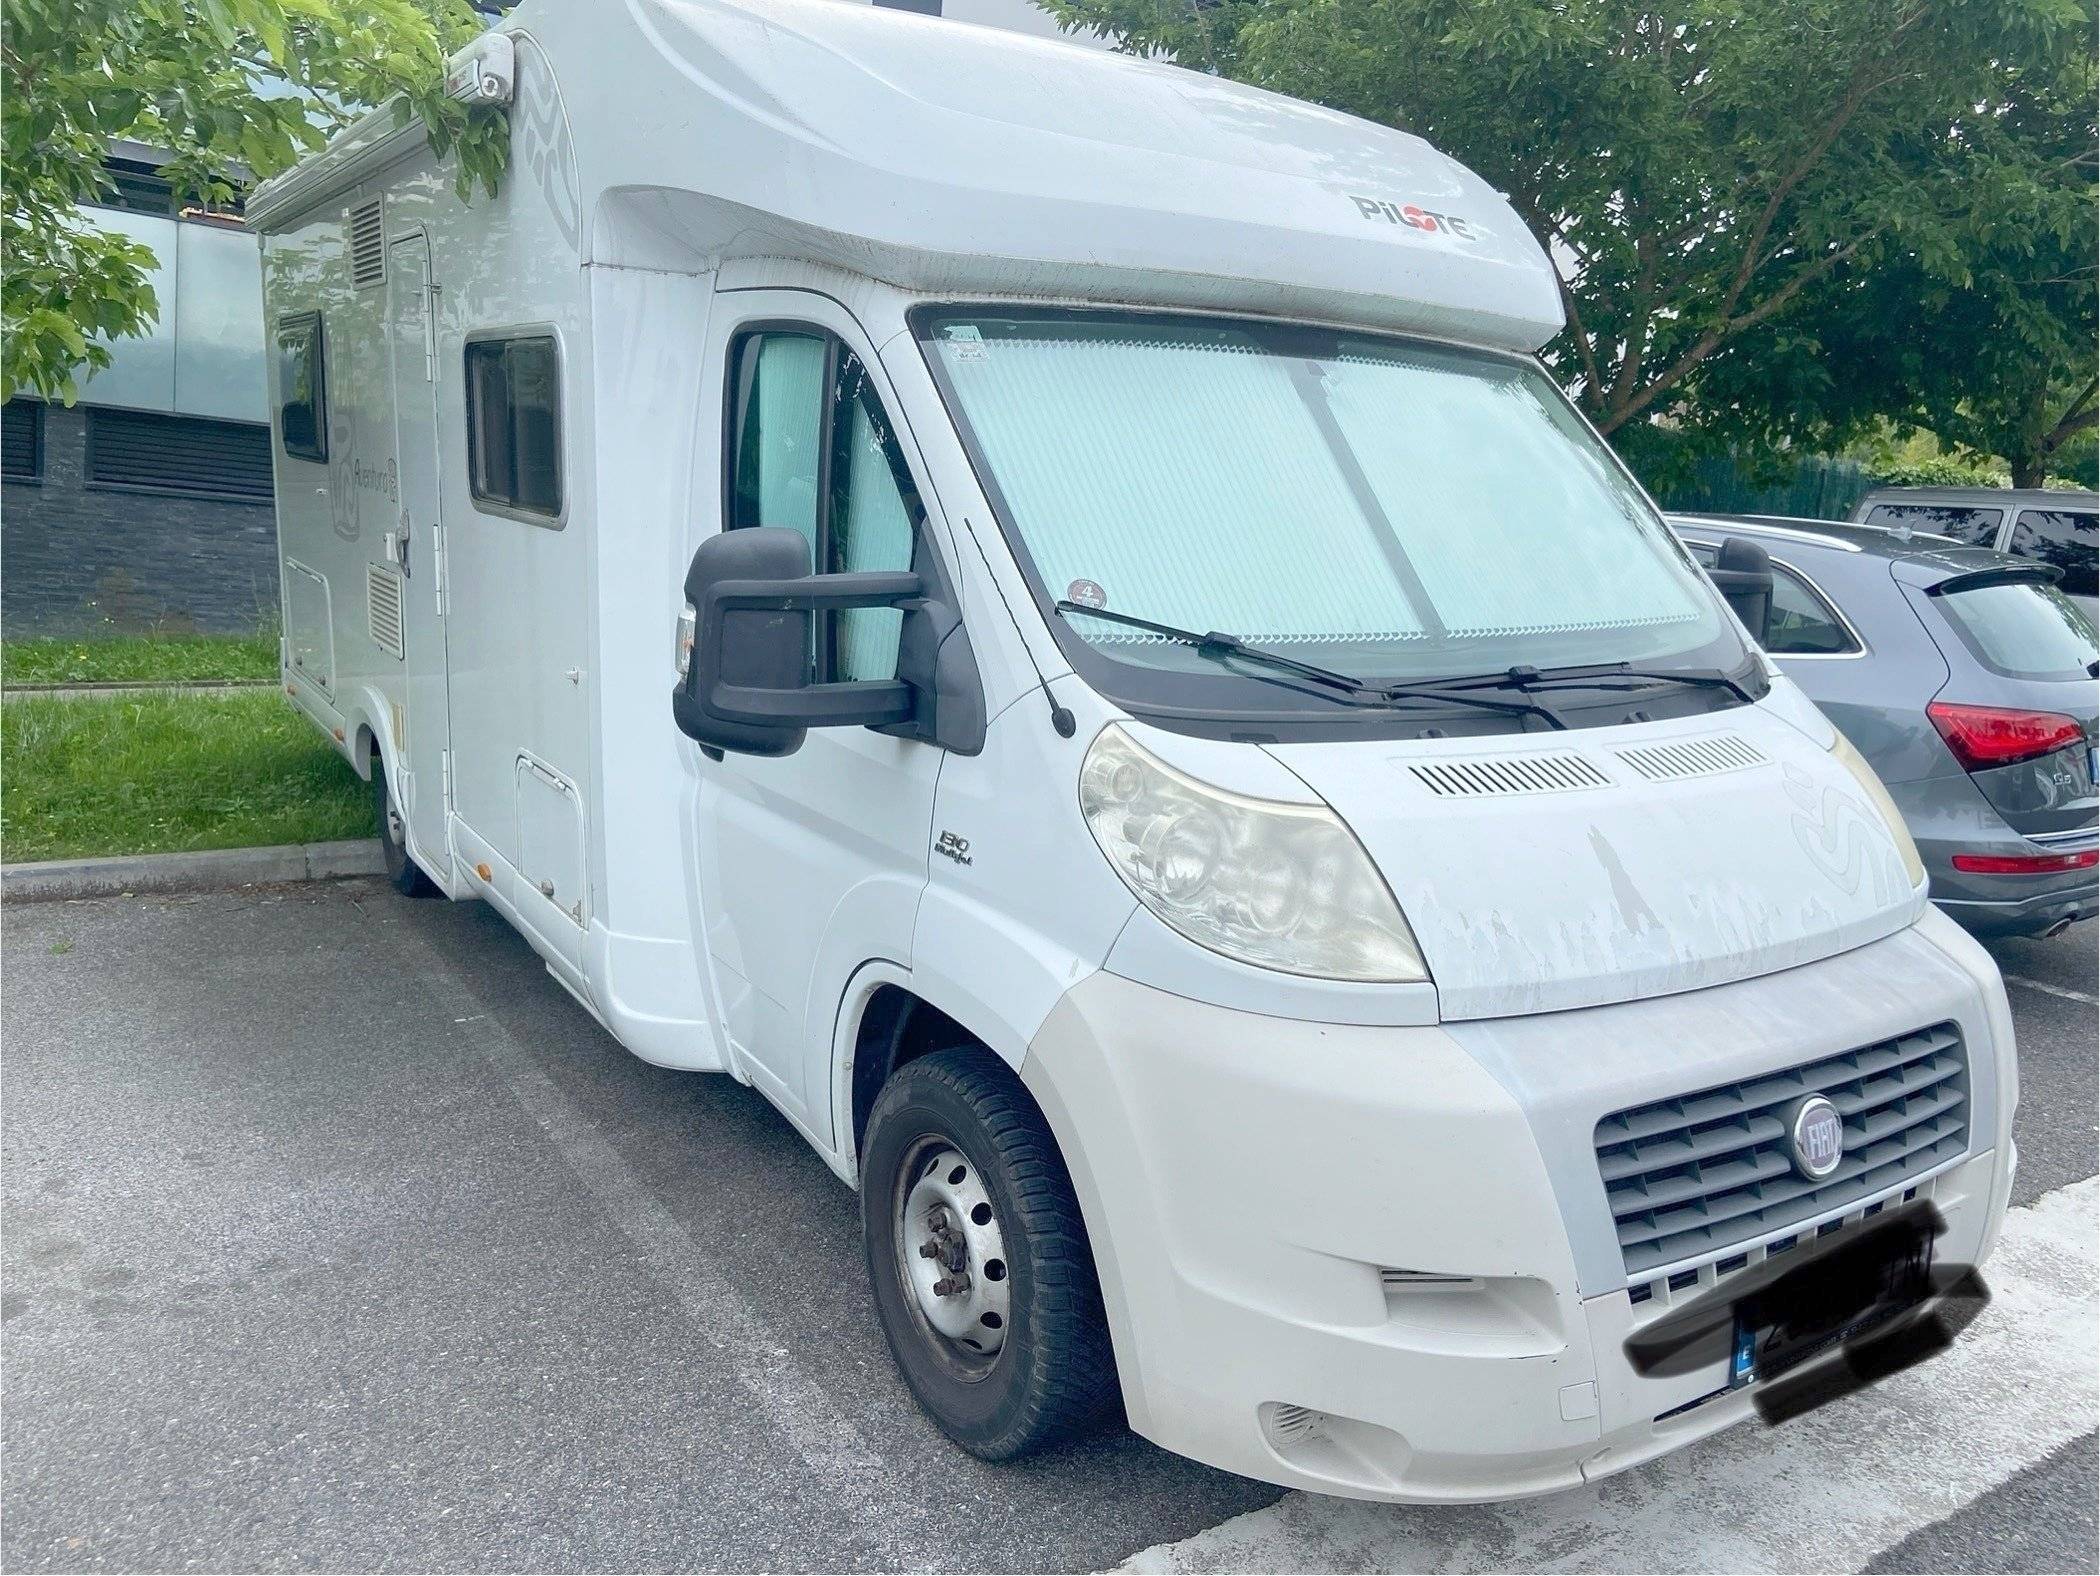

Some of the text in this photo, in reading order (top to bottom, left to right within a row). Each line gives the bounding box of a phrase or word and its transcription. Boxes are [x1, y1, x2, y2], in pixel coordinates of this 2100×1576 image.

[1081, 585, 1094, 598] 4
[939, 829, 970, 852] 130
[1806, 1118, 1840, 1160] FIAT
